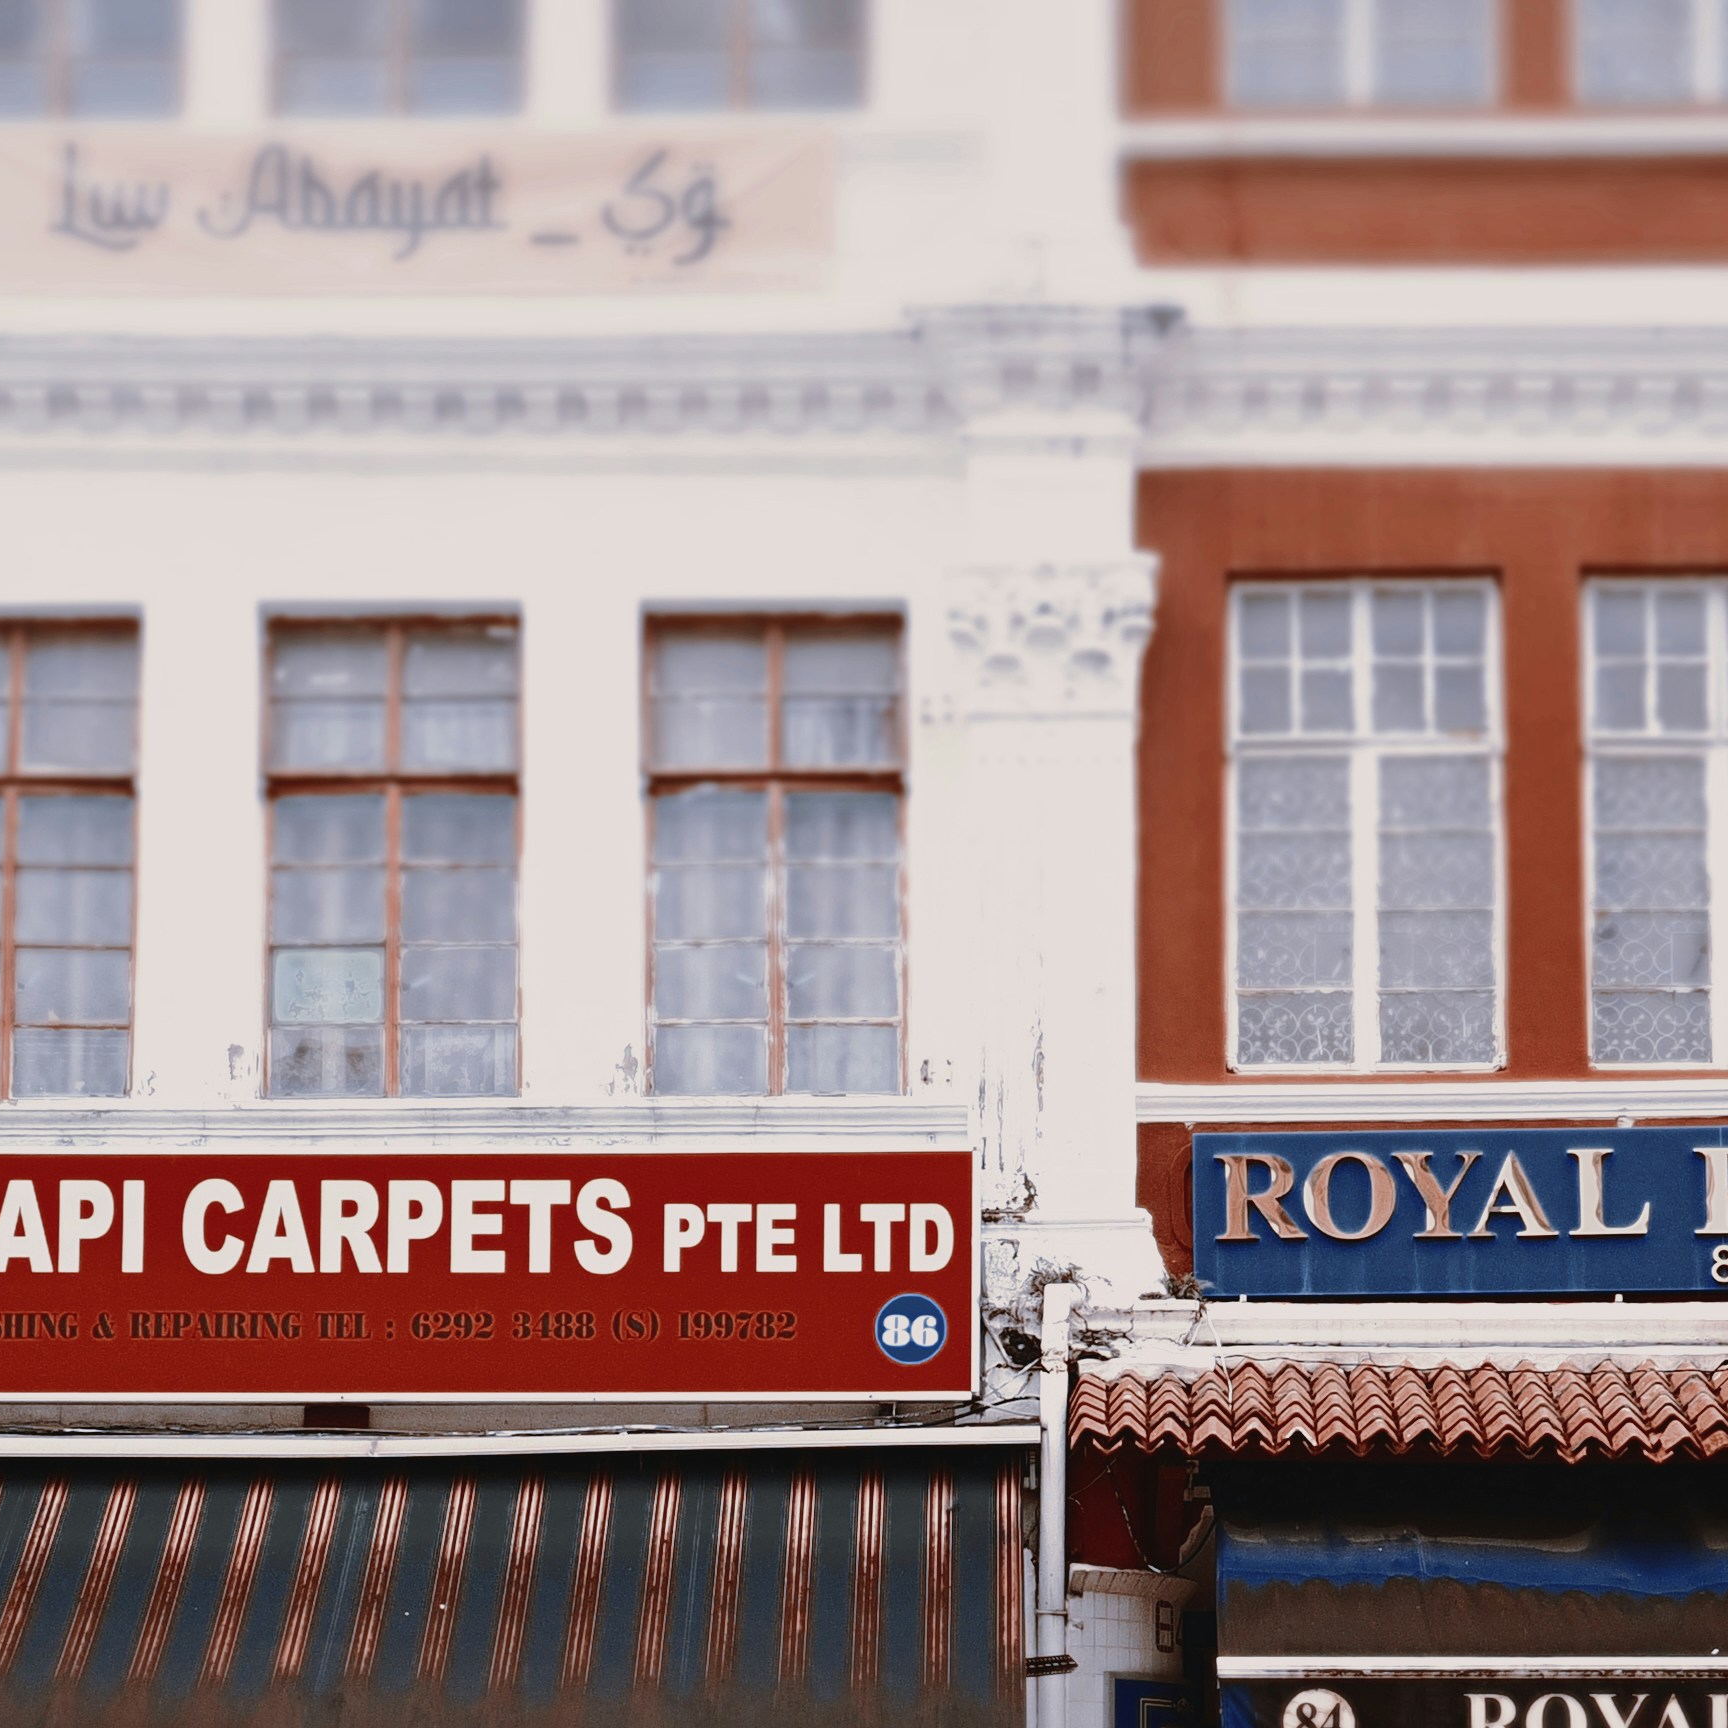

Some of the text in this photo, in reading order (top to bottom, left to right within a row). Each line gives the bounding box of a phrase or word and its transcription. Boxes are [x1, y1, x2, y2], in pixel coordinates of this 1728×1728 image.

[182, 1177, 633, 1275] CARPETS
[663, 1203, 798, 1273] PTE
[823, 1203, 955, 1273] LTD
[1212, 1146, 1652, 1241] ROYAL
[90, 1311, 117, 1340] &
[128, 1310, 302, 1341] REPAIRING
[315, 1310, 372, 1341] TEL
[410, 1310, 496, 1341] 6292
[510, 1309, 597, 1341] 3488
[610, 1309, 662, 1342] (S)
[882, 1313, 940, 1349] 86
